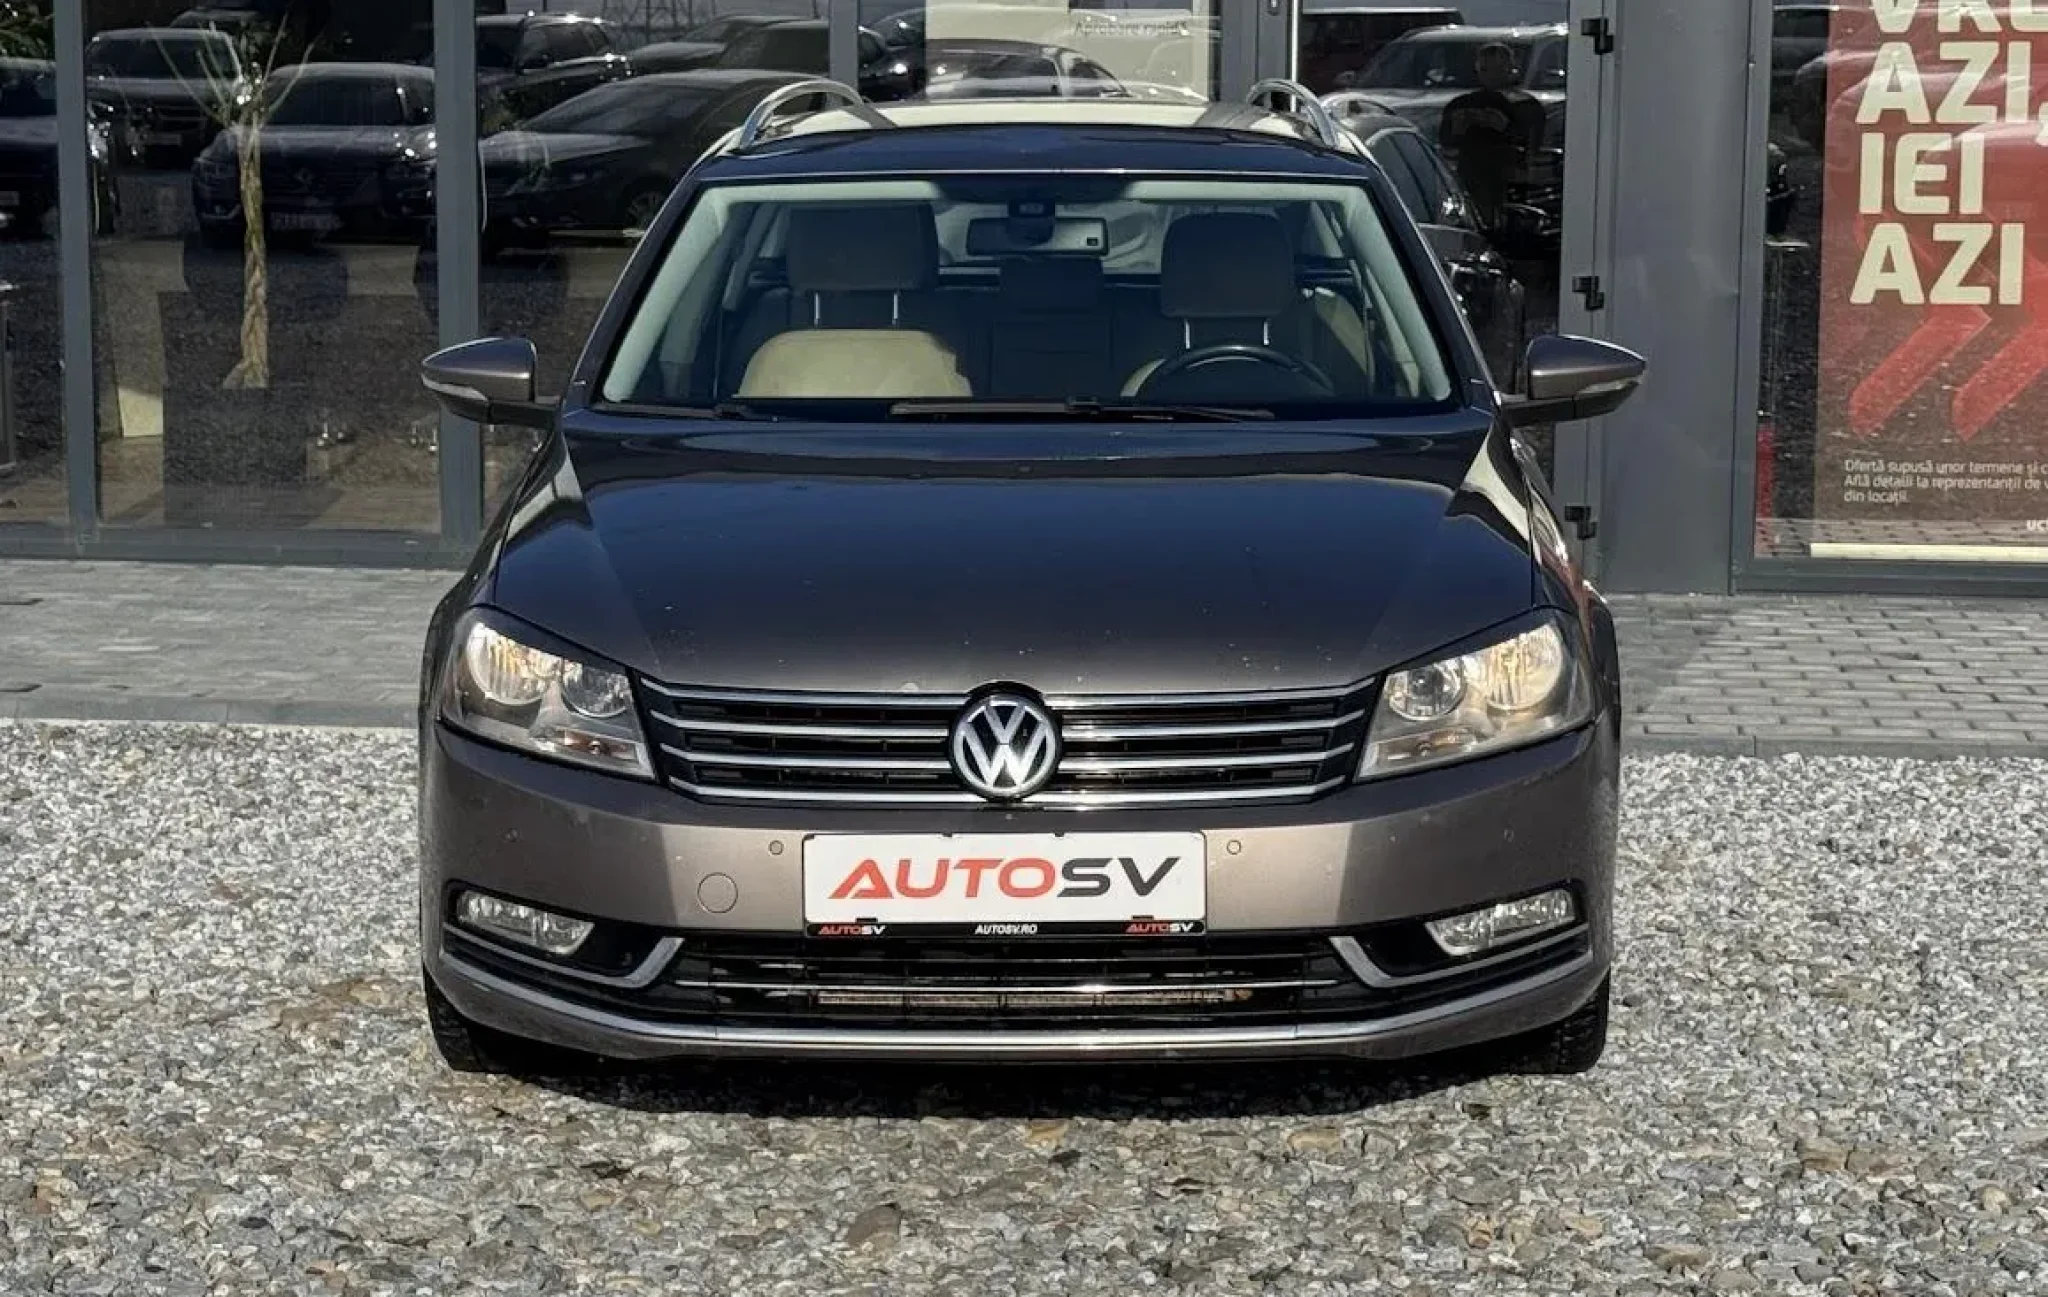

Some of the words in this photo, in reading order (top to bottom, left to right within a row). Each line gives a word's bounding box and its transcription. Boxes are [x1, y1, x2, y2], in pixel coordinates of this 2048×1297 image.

[1859, 132, 1985, 215] IEI
[1850, 222, 2025, 305] AZI
[1845, 458, 1884, 473] Ofertă
[1887, 459, 1933, 476] supusă
[1935, 462, 1964, 475] unor
[1969, 461, 2024, 475] termene
[1844, 474, 1870, 488] Află
[1873, 474, 1912, 489] detalii
[1916, 475, 1930, 489] la
[2024, 477, 2040, 490] de
[1844, 489, 1865, 502] din
[828, 857, 1182, 900] AUTOSV
[818, 923, 886, 935] AUTOSV
[1125, 921, 1194, 933] AUTOSV
